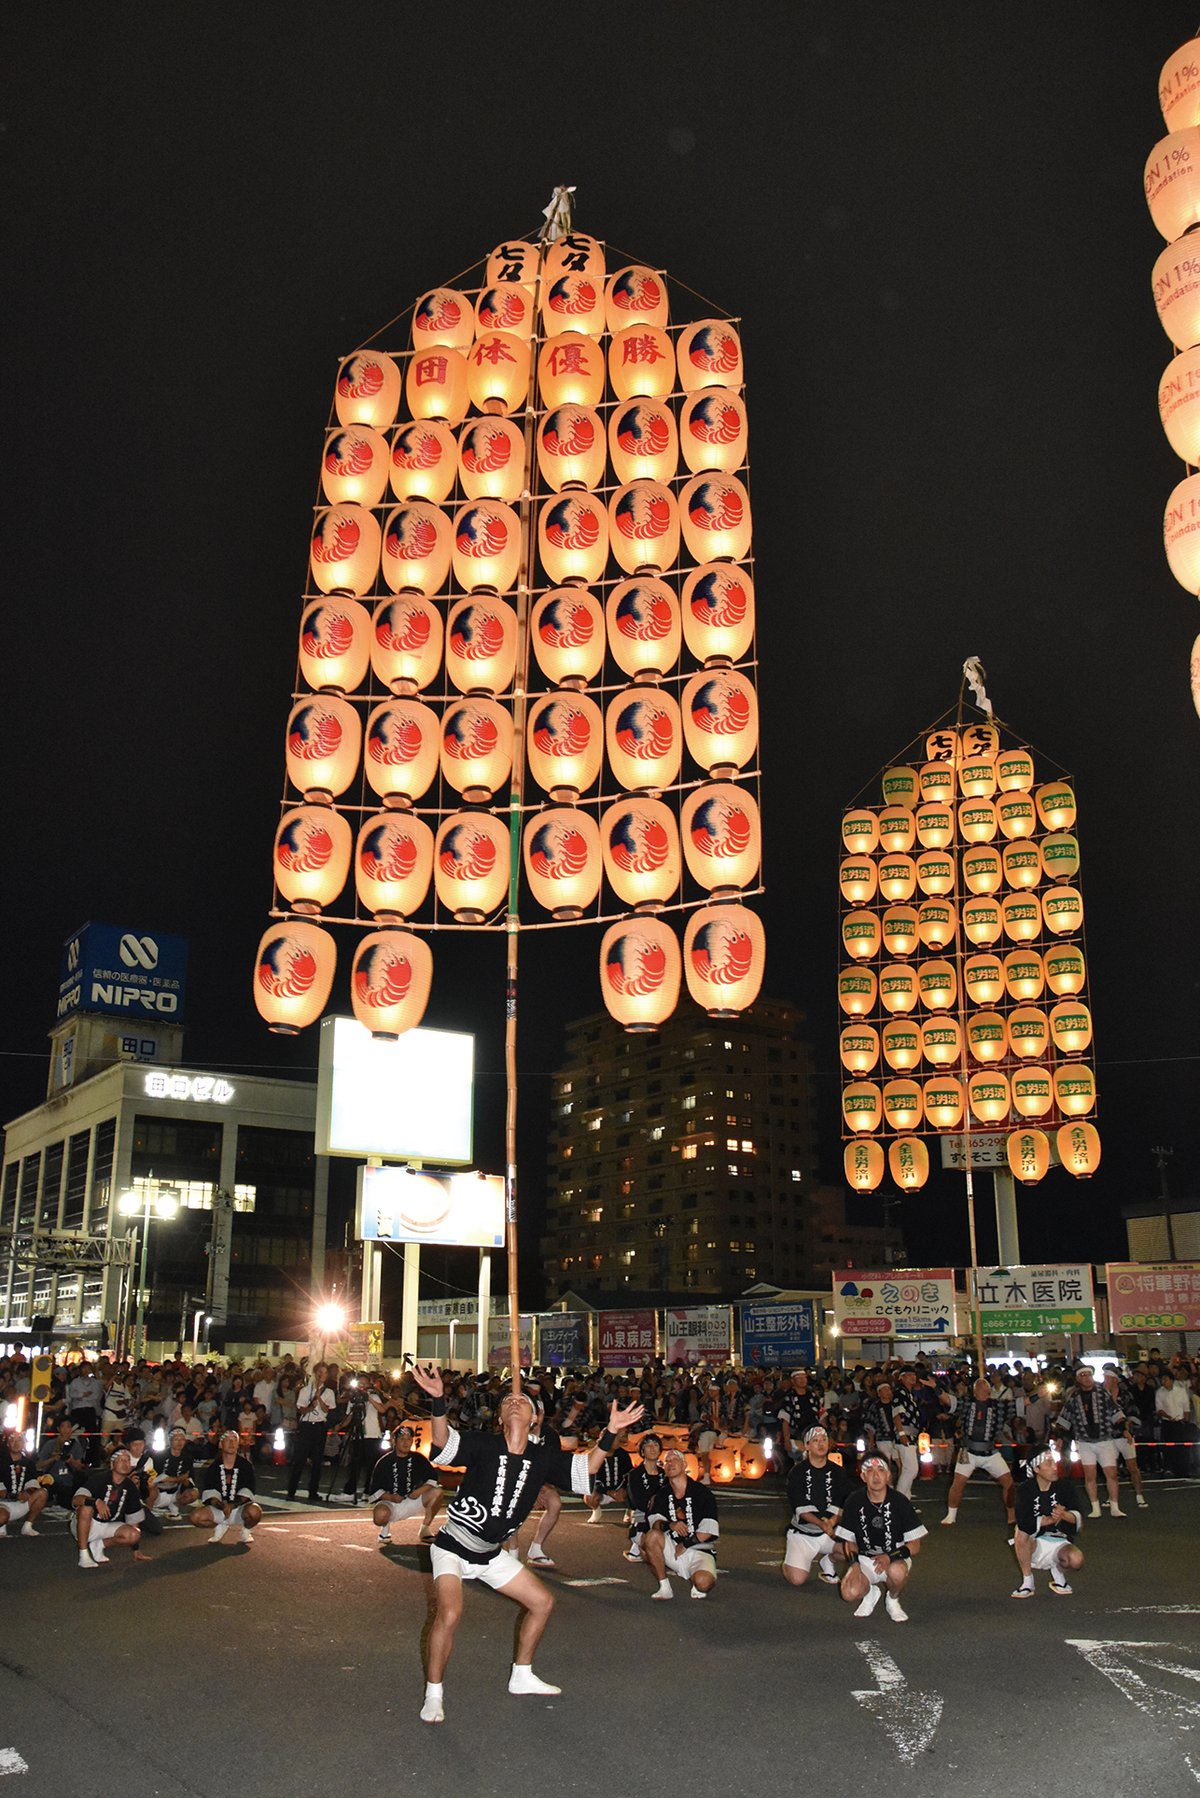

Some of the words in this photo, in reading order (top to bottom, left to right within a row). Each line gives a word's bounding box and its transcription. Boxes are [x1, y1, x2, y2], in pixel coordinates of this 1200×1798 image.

[1164, 148, 1190, 170] 1%
[561, 236, 590, 271] 七夕
[496, 246, 525, 282] 七夕
[963, 767, 992, 782] 全労済
[1000, 762, 1030, 777] 全労済
[885, 778, 913, 793] 全労済
[922, 772, 950, 788] 全労済
[1043, 795, 1073, 810] 全労済
[963, 810, 993, 825] 全労済
[1002, 804, 1032, 819] 全労済
[844, 821, 872, 836] 全労済
[880, 819, 909, 834] 全労済
[919, 815, 948, 830] 全労済
[1045, 844, 1076, 859] 全労済
[966, 860, 997, 875] 全労済
[1006, 853, 1038, 868] 全労済
[841, 868, 870, 881] 全労済
[880, 866, 909, 881] 全労済
[919, 863, 949, 877] 全労済
[1006, 905, 1037, 920] 全労済
[1047, 899, 1079, 912] 全労済
[919, 908, 948, 923] 全労済
[966, 910, 998, 925] 全労済
[845, 924, 874, 939] 全労済
[885, 921, 914, 935] 全労済
[968, 967, 999, 982] 全労済
[1008, 965, 1040, 980] 全労済
[1049, 959, 1081, 975] 全労済
[840, 978, 871, 993] 全労済
[882, 979, 912, 993] 全労済
[920, 975, 951, 990] 全労済
[57, 984, 80, 1016] NIPRO
[92, 983, 178, 1012] NIPRO
[1012, 1023, 1044, 1037] 全労済
[1055, 1016, 1088, 1031] 全労済
[924, 1031, 956, 1045] 全労済
[971, 1026, 1003, 1041] 全労済
[844, 1038, 873, 1051] 全労済
[886, 1035, 917, 1050] 全労済
[148, 1074, 232, 1100] 田口ビル
[973, 1086, 1006, 1101] 全労済
[1016, 1081, 1049, 1095] 全労済
[1058, 1082, 1091, 1096] 全労済
[845, 1097, 876, 1112] 全労済
[886, 1096, 917, 1111] 全労済
[927, 1093, 958, 1107] 全労済
[1020, 1135, 1036, 1172] 全労済
[1072, 1128, 1088, 1164] 全労済
[855, 1145, 868, 1180] 全労済
[898, 1143, 914, 1178] 全労済
[880, 1282, 939, 1303] えのき
[978, 1280, 1083, 1303] 立木医院
[875, 1305, 949, 1315] こどもクリニック
[669, 1321, 708, 1337] 山王眼科
[745, 1314, 810, 1333] 山王整形外科
[603, 1331, 652, 1348] 小泉病院
